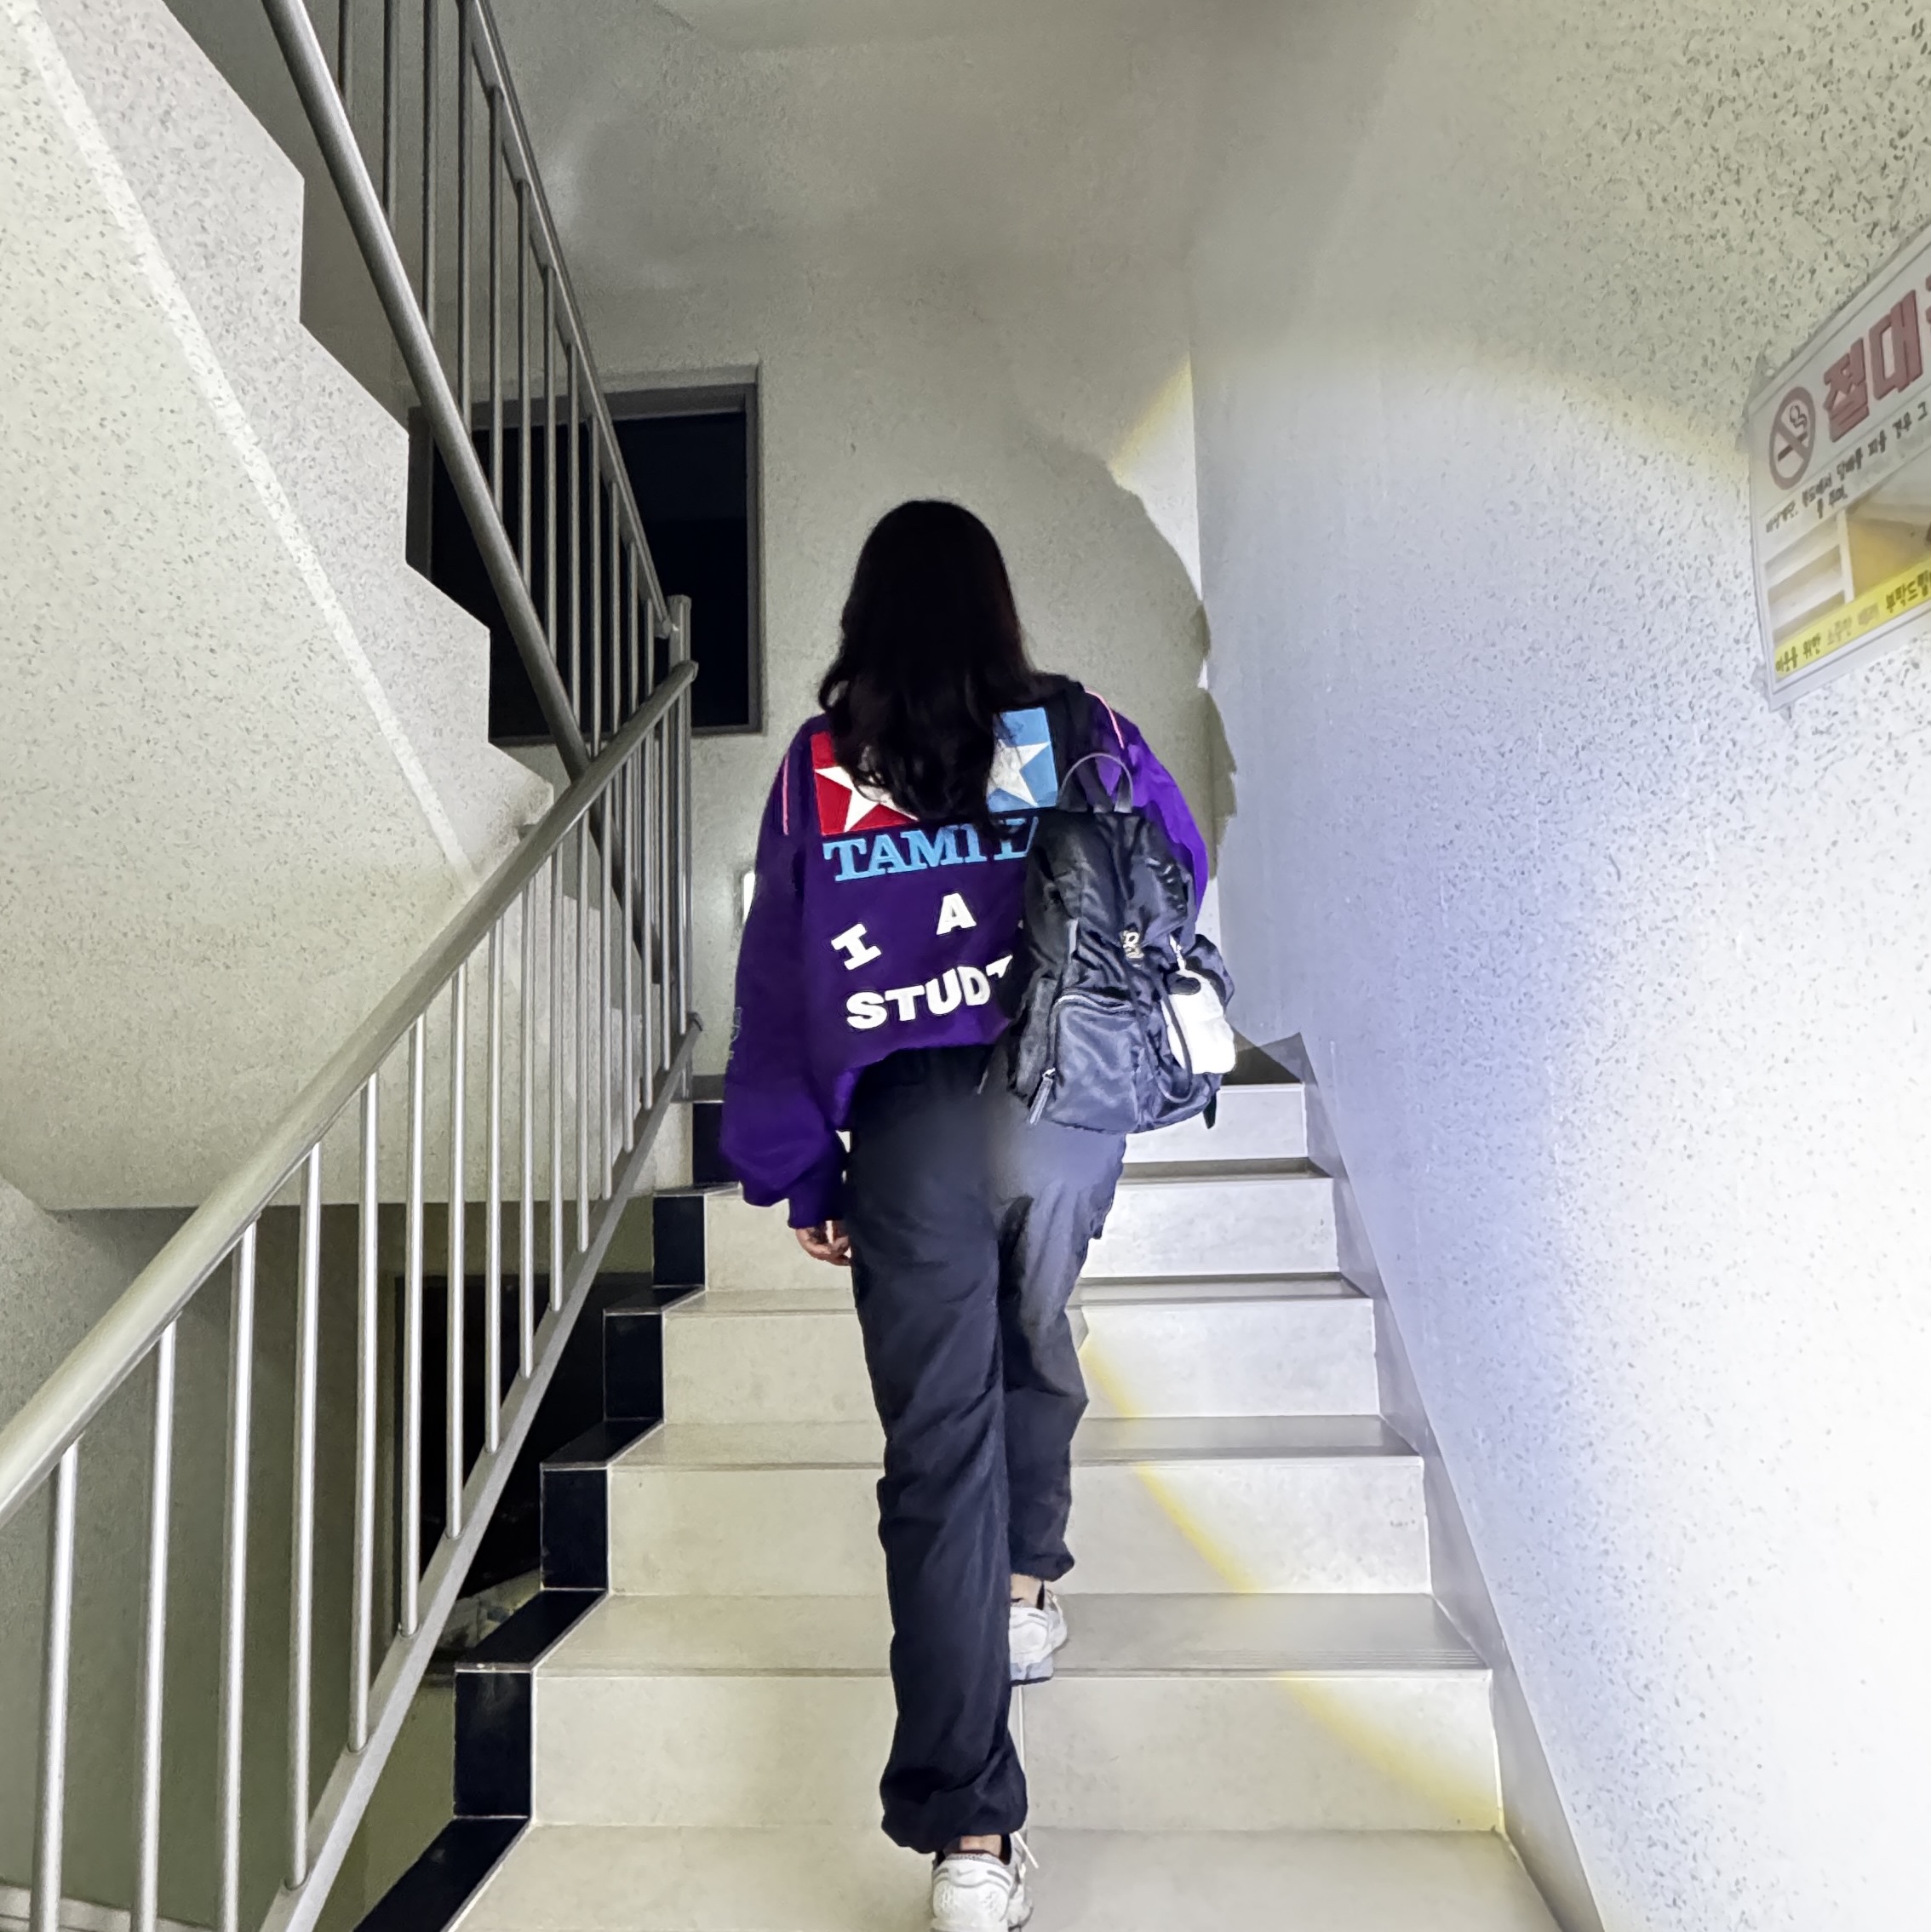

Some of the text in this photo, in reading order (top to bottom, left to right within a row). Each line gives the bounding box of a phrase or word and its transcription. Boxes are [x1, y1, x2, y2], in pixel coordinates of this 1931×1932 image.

[1823, 273, 1931, 443] 절대
[1836, 447, 1863, 481] 담배를
[1893, 411, 1912, 439] 경우
[1802, 633, 1821, 659] 위한
[1886, 570, 1931, 614] 부탁드립
[822, 816, 1039, 882] TAMI
[831, 923, 881, 971] I
